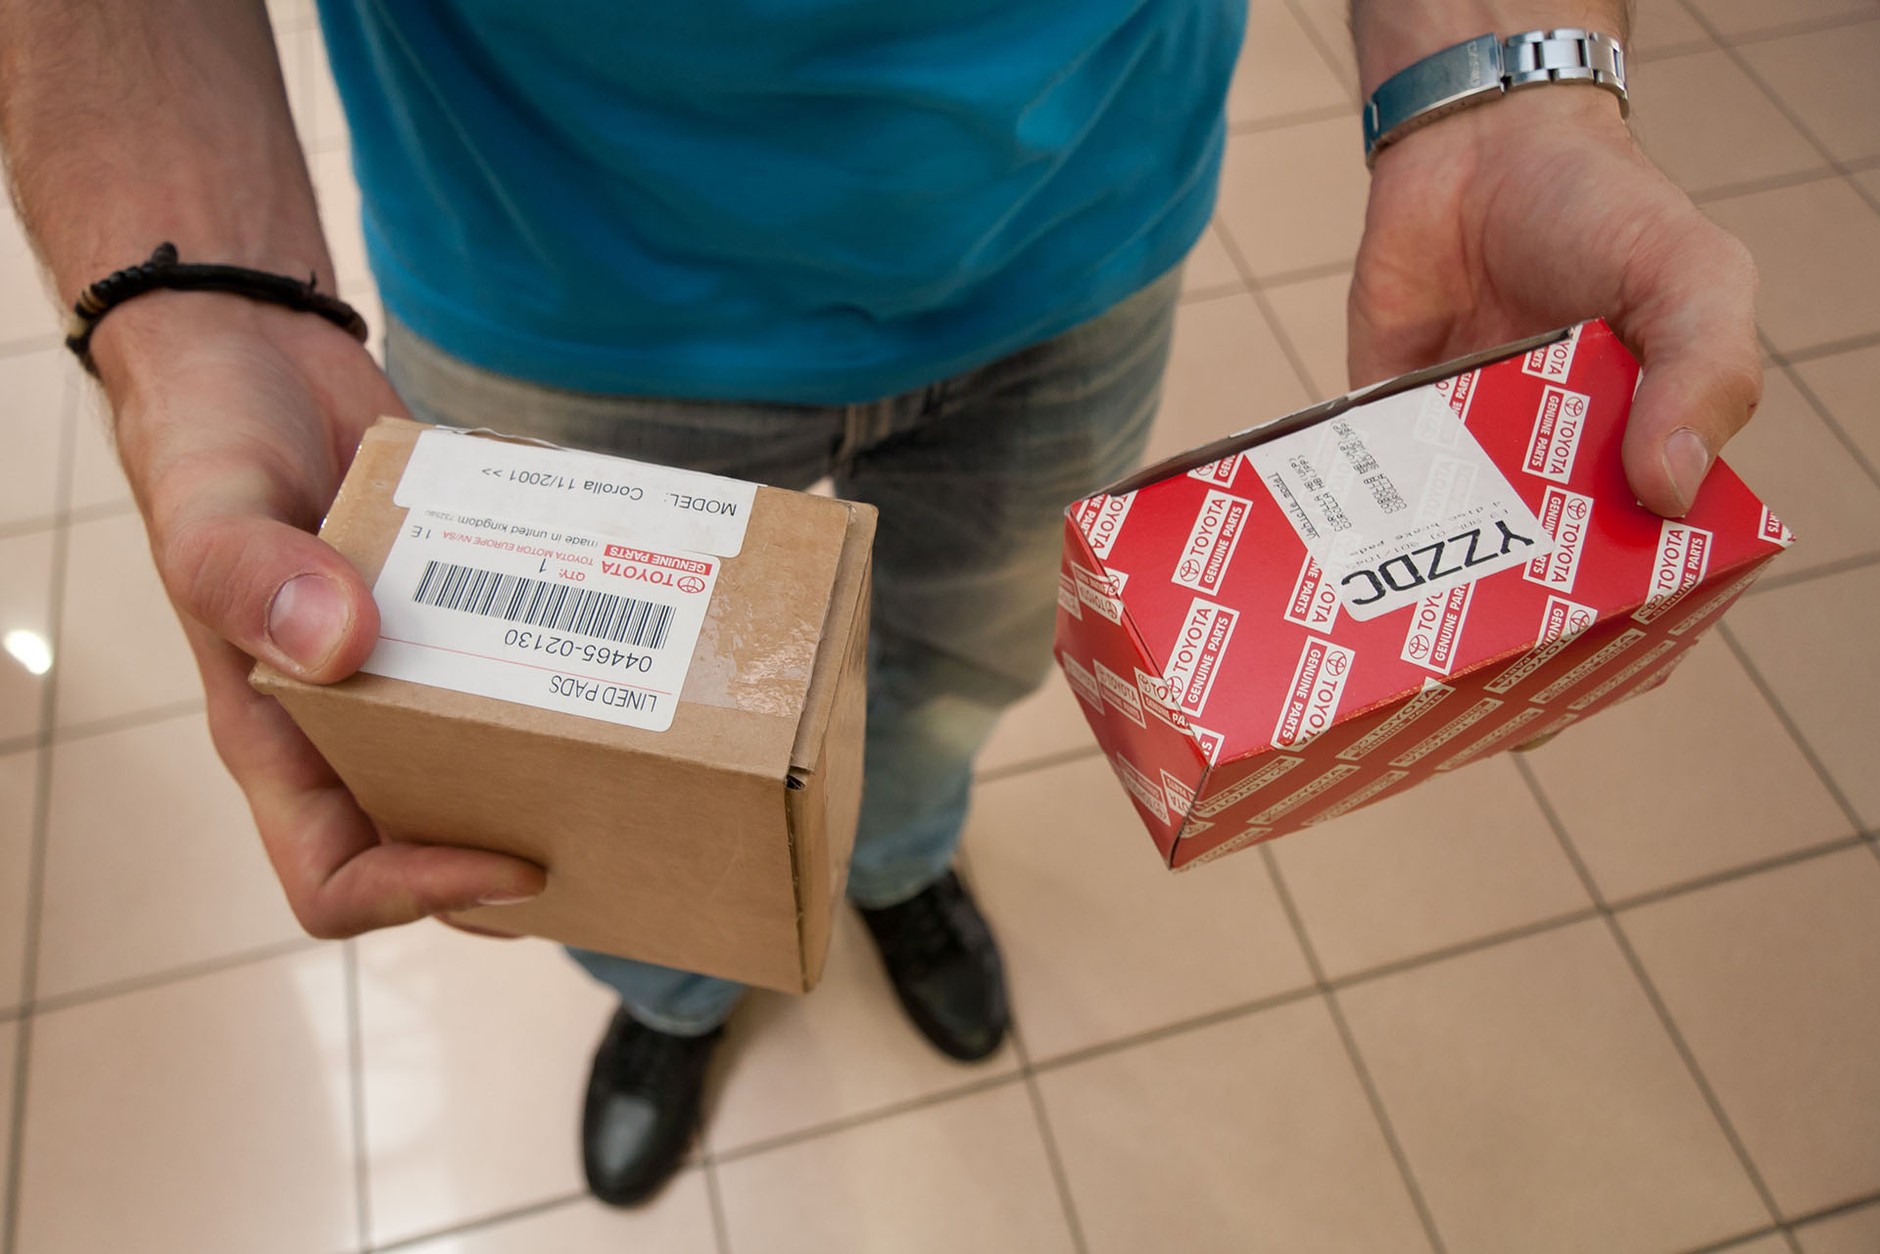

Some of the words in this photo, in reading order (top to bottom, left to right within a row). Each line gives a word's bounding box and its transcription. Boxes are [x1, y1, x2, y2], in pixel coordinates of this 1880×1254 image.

[1540, 395, 1560, 436] GENUINE
[1531, 437, 1550, 467] PARTS
[1549, 419, 1578, 475] TOYOTA
[509, 470, 575, 491] 11/2001
[584, 479, 644, 501] Corolla
[663, 491, 737, 517] MODEL:
[410, 526, 423, 539] E
[457, 514, 508, 535] kingdom
[509, 522, 549, 539] united
[1189, 498, 1226, 555] TOYOTA
[1290, 502, 1320, 540] Vehicle
[442, 530, 473, 545] NV/SA
[473, 536, 514, 553] EUROPE
[551, 530, 563, 541] in
[566, 530, 598, 547] made
[1204, 538, 1228, 584] GENUINE
[1223, 505, 1243, 538] PARTS
[514, 544, 553, 559] MOTOR
[539, 558, 547, 573] 1
[557, 551, 594, 567] TOYOTA
[609, 545, 647, 564] PARTS
[651, 555, 706, 572] GENUINE
[1341, 520, 1535, 605] YZZDC
[1551, 523, 1580, 584] TOYOTA
[1657, 529, 1684, 591] TOYOTA
[558, 567, 586, 582] QTY:
[601, 561, 674, 587] TOYOTA
[1653, 572, 1697, 617] GENUINE
[1689, 537, 1704, 570] PARTS
[1294, 581, 1315, 615] PARTS
[504, 628, 652, 673] 04465-02130
[1173, 607, 1212, 673] TOYOTA
[1434, 623, 1458, 661] GENUINE
[1187, 653, 1214, 703] GENUINE
[1207, 616, 1229, 652] PARTS
[549, 674, 599, 700] PADS
[1297, 649, 1321, 699] GENUINE
[602, 687, 657, 713] LINED
[1300, 680, 1337, 744] TOYOTA
[1368, 688, 1439, 737] TOYOTA
[1282, 701, 1304, 740] PARTS
